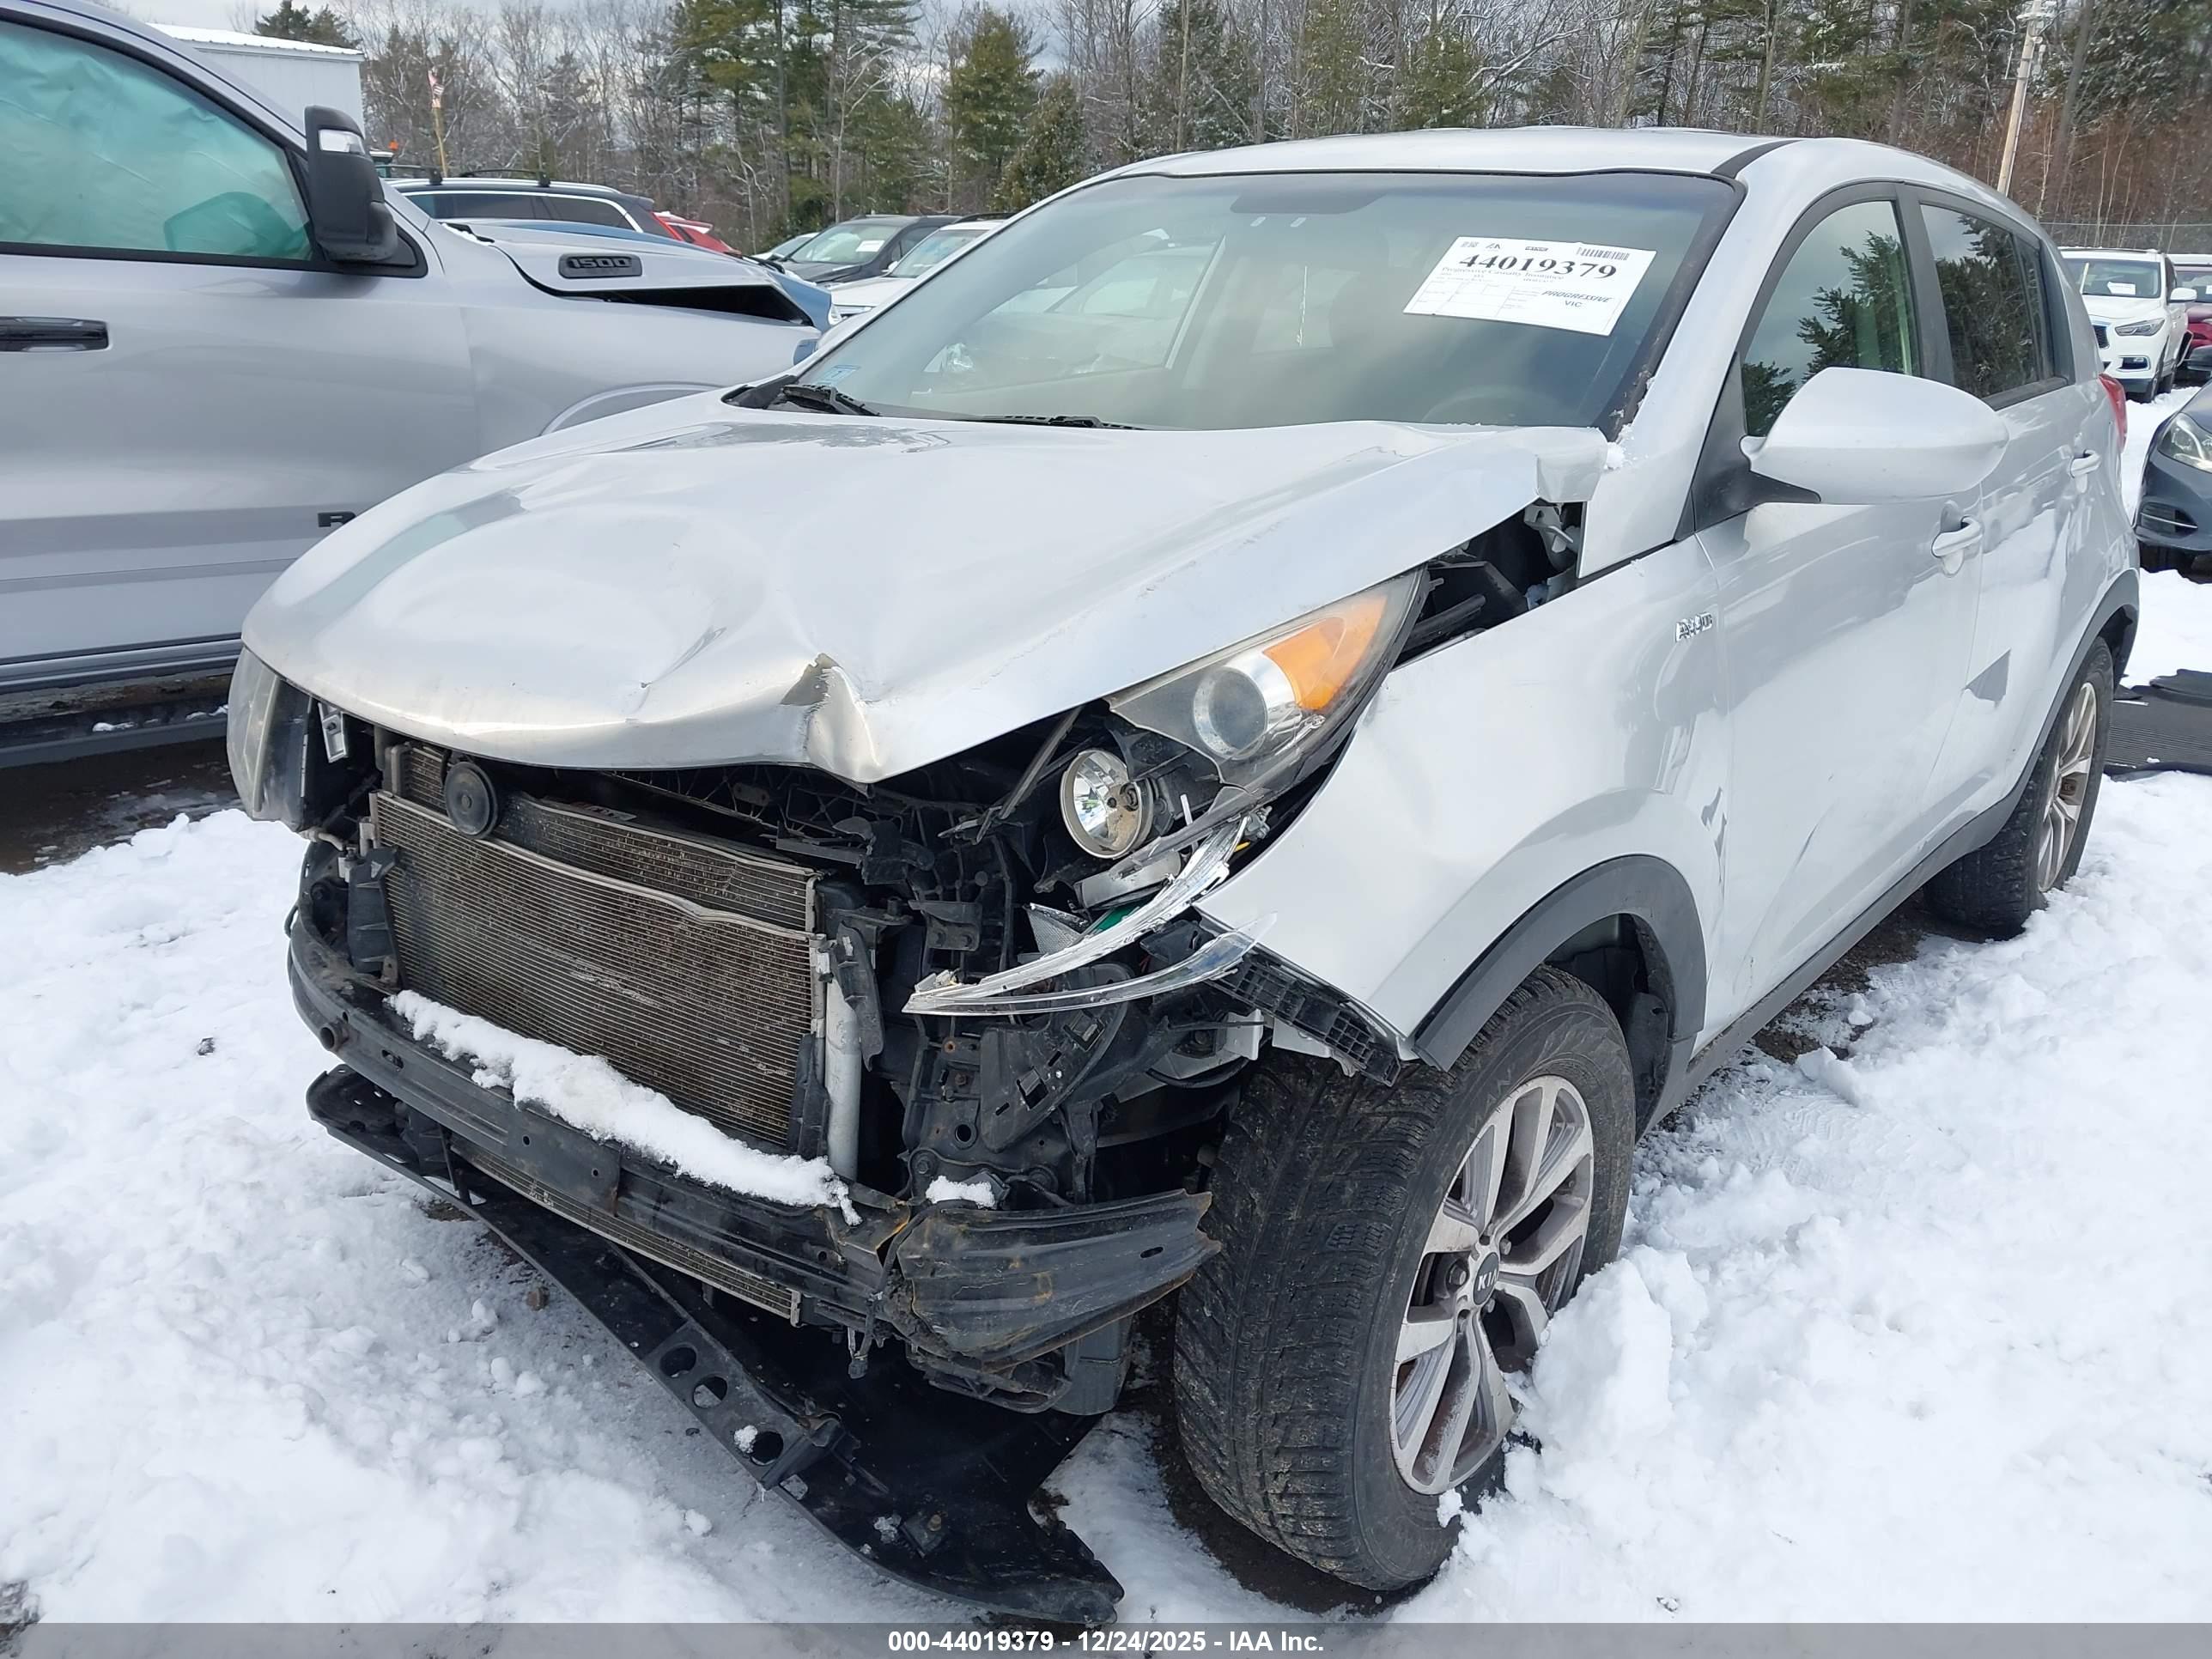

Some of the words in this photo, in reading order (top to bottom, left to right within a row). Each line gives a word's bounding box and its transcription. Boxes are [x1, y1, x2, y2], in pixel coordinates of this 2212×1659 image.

[568, 257, 632, 269] 1500
[1459, 254, 1617, 278] 44019379
[1541, 290, 1613, 302] PROGRESSIVE
[1477, 1268, 1498, 1291] KIA
